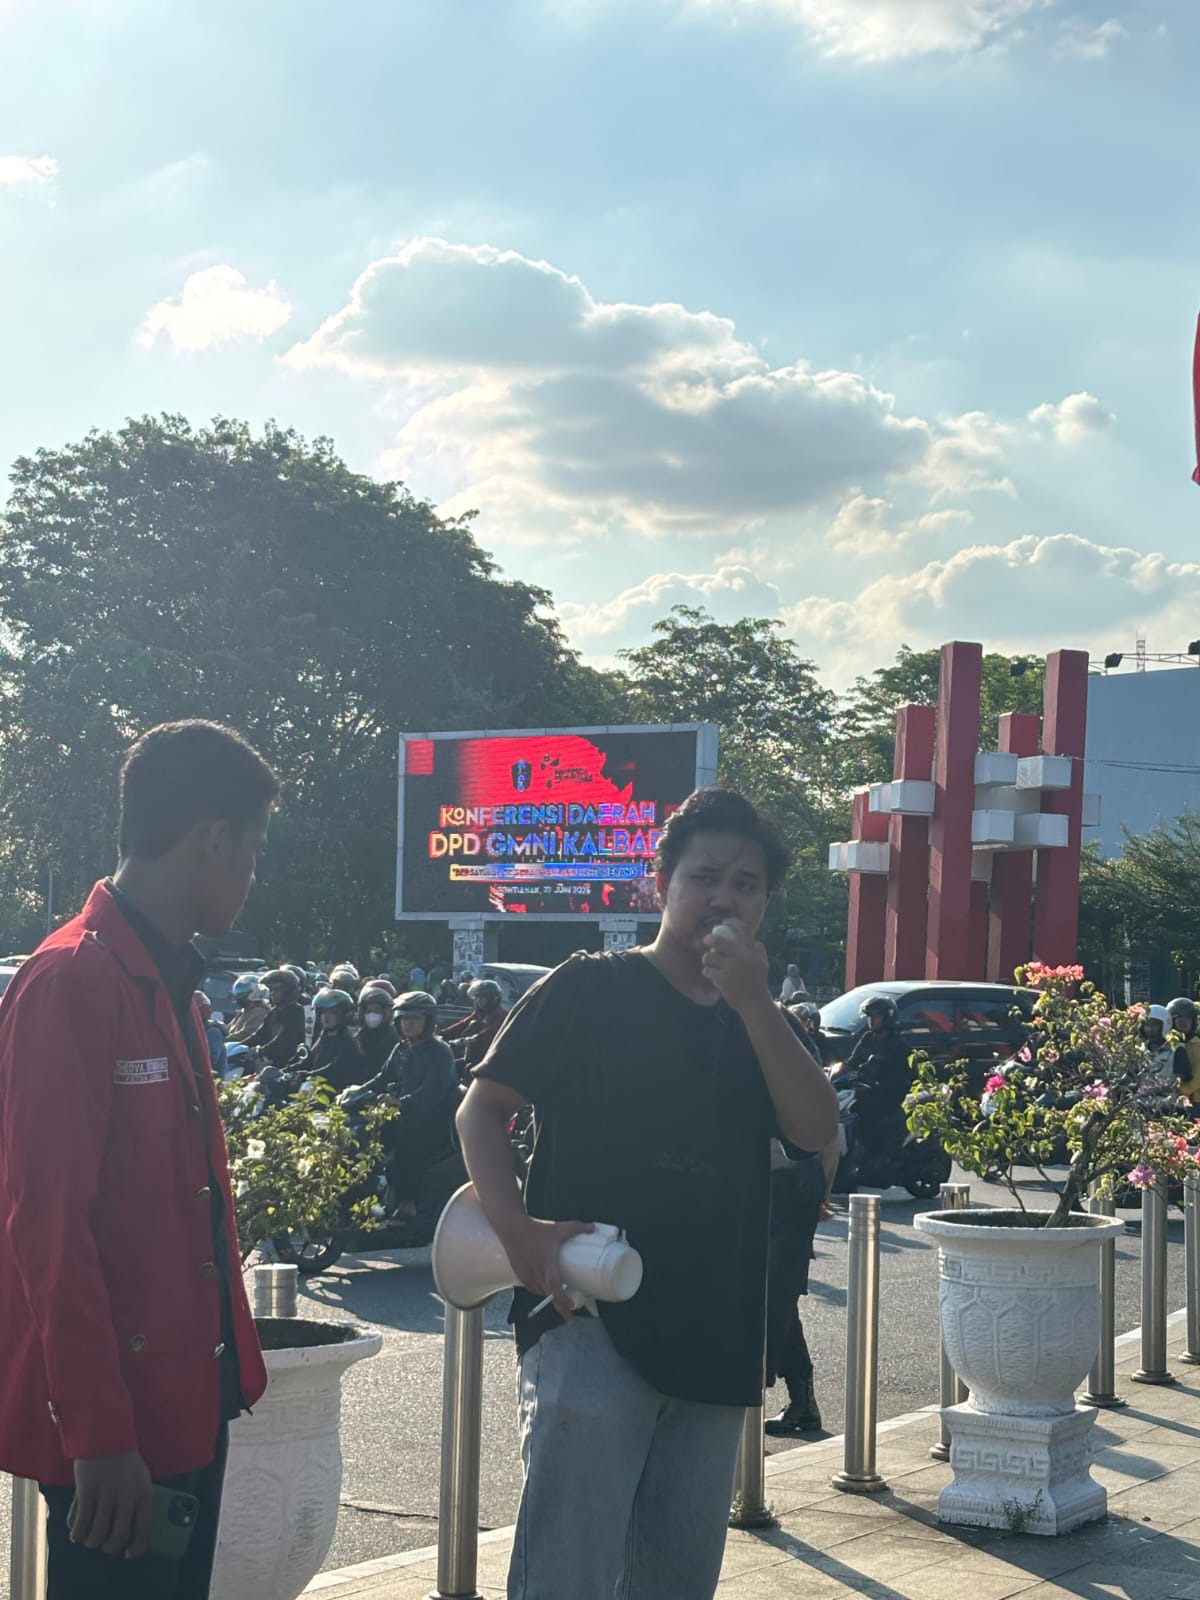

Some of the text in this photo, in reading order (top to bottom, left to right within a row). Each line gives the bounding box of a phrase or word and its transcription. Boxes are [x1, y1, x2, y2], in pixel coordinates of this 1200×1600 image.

[441, 803, 655, 826] KONFERENSI DAERAH
[431, 832, 480, 857] DPD
[487, 832, 556, 856] GMNI
